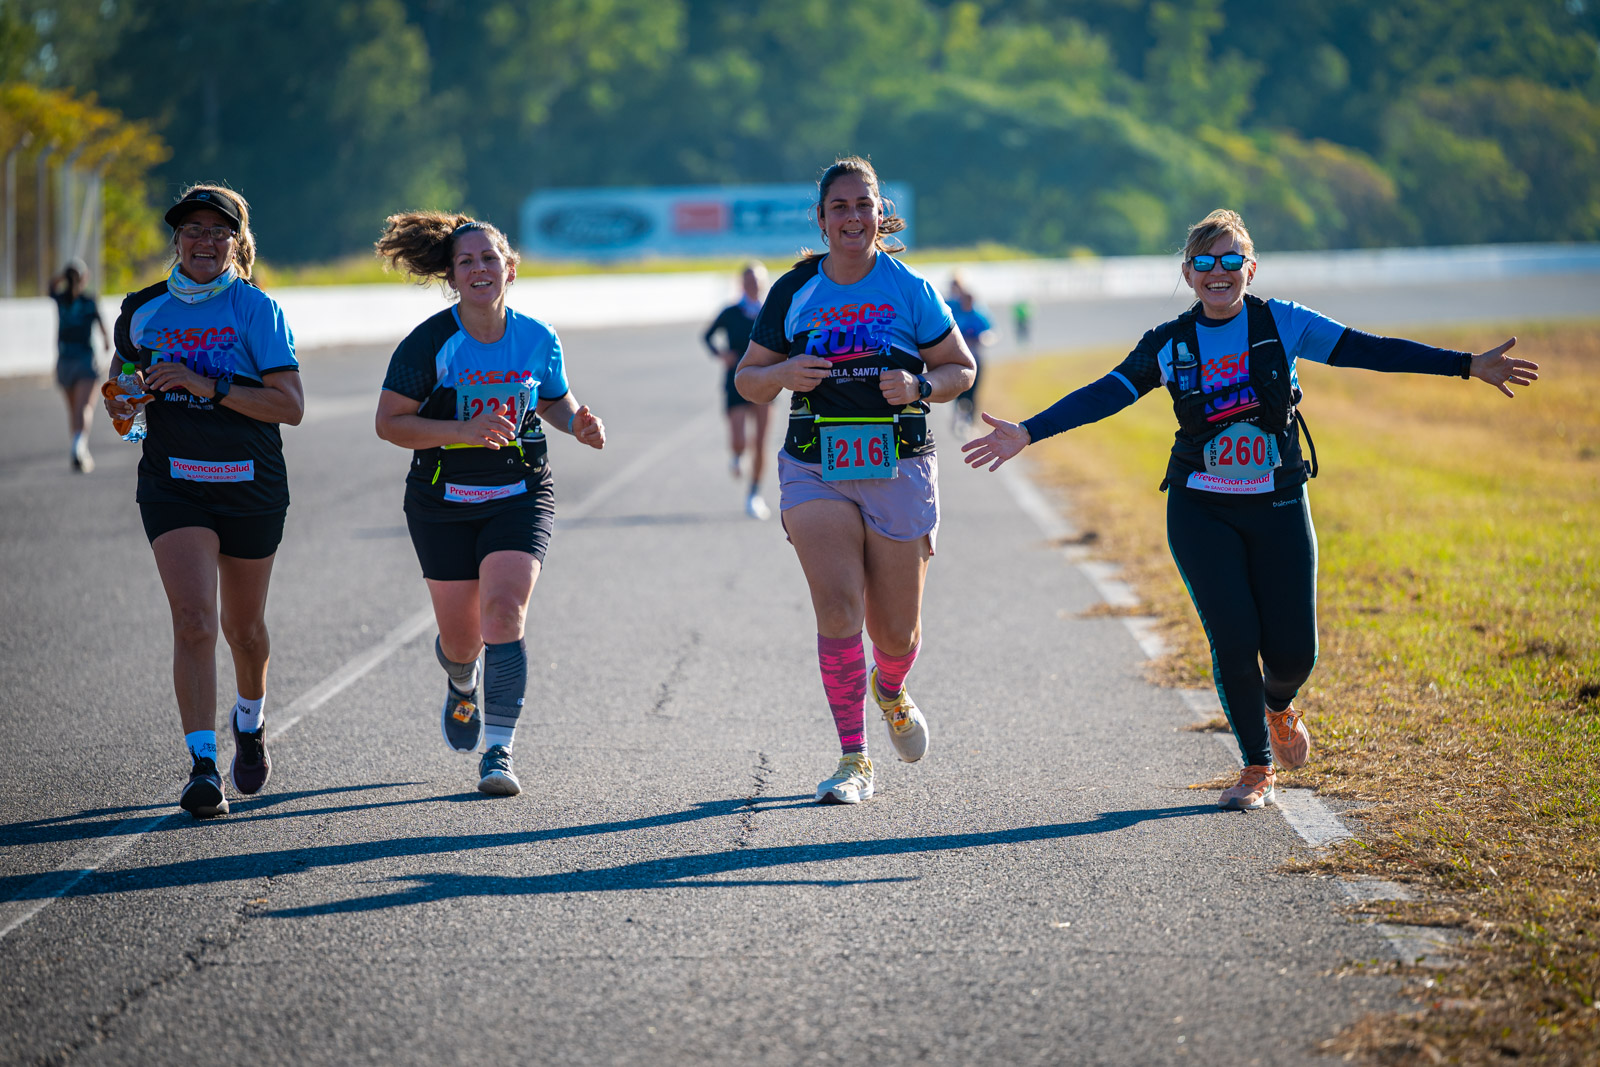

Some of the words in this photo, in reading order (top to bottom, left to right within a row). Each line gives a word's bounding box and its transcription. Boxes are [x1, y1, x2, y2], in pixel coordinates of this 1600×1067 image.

[869, 311, 896, 319] MILLAS
[805, 325, 886, 356] RUN
[852, 367, 879, 377] SANTA
[1219, 351, 1249, 379] 50
[835, 437, 883, 468] 216
[882, 433, 890, 467] EXACTO
[1218, 436, 1266, 466] 260
[173, 460, 223, 473] Prevención
[224, 463, 250, 473] Salud
